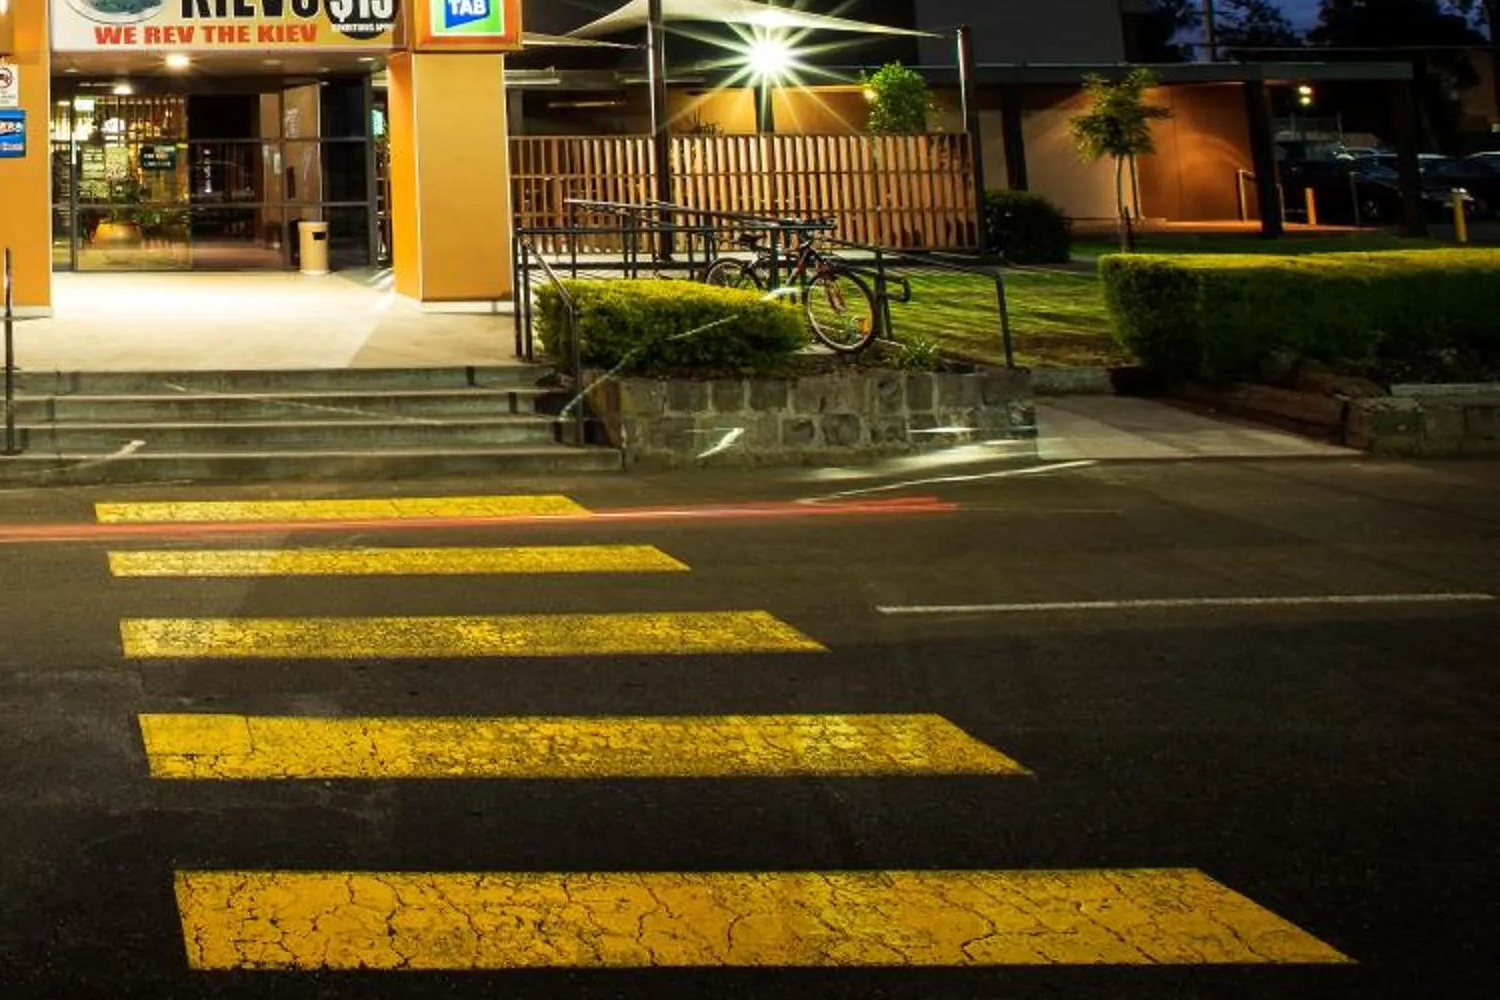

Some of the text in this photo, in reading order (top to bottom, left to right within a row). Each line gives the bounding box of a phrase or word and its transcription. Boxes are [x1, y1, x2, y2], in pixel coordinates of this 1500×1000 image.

[94, 26, 138, 45] WE
[144, 26, 195, 45] REV
[201, 25, 250, 44] THE
